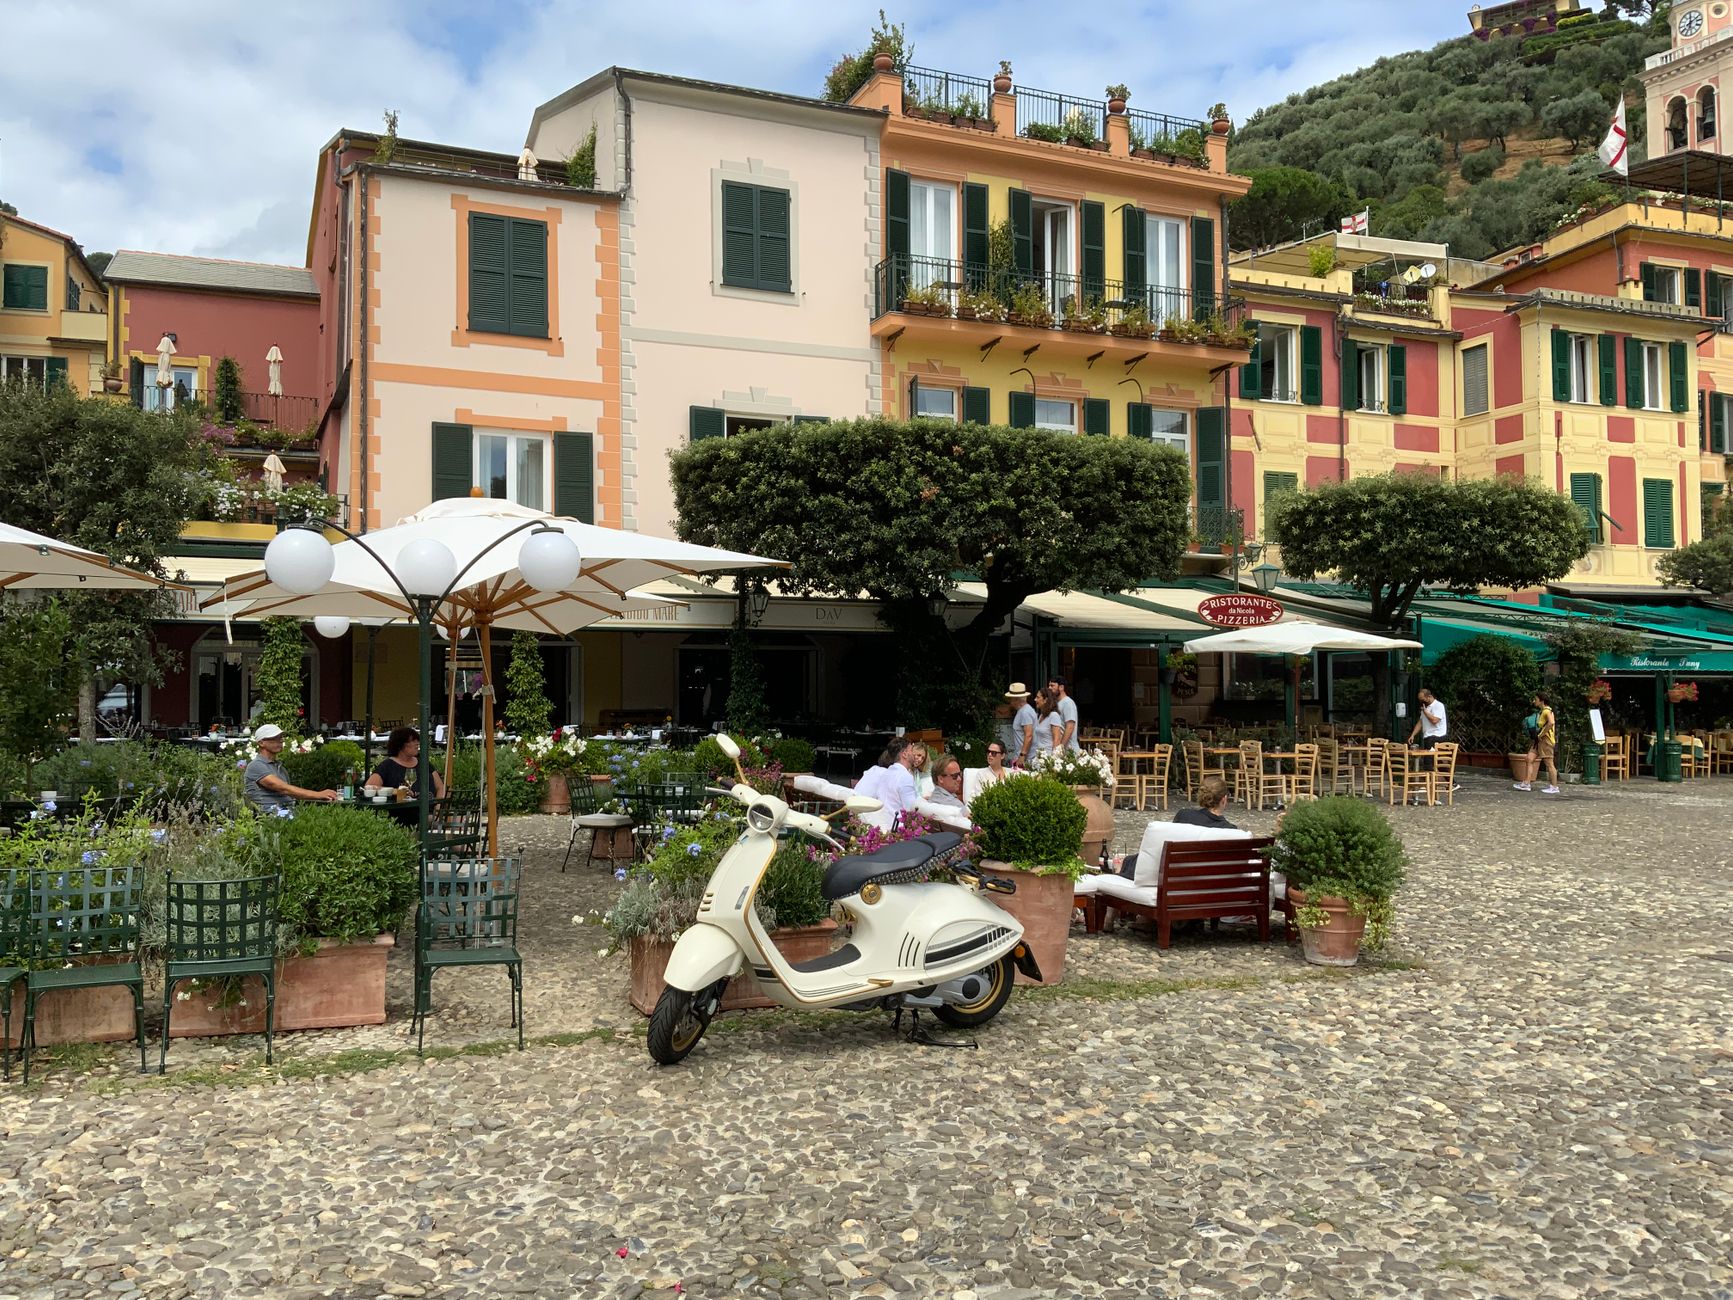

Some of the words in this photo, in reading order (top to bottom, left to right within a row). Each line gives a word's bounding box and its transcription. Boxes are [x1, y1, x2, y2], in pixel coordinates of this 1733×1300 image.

[1210, 597, 1272, 609] RISTORANTE
[1217, 615, 1265, 625] PIZZERIA
[1630, 656, 1669, 667] Ristorante
